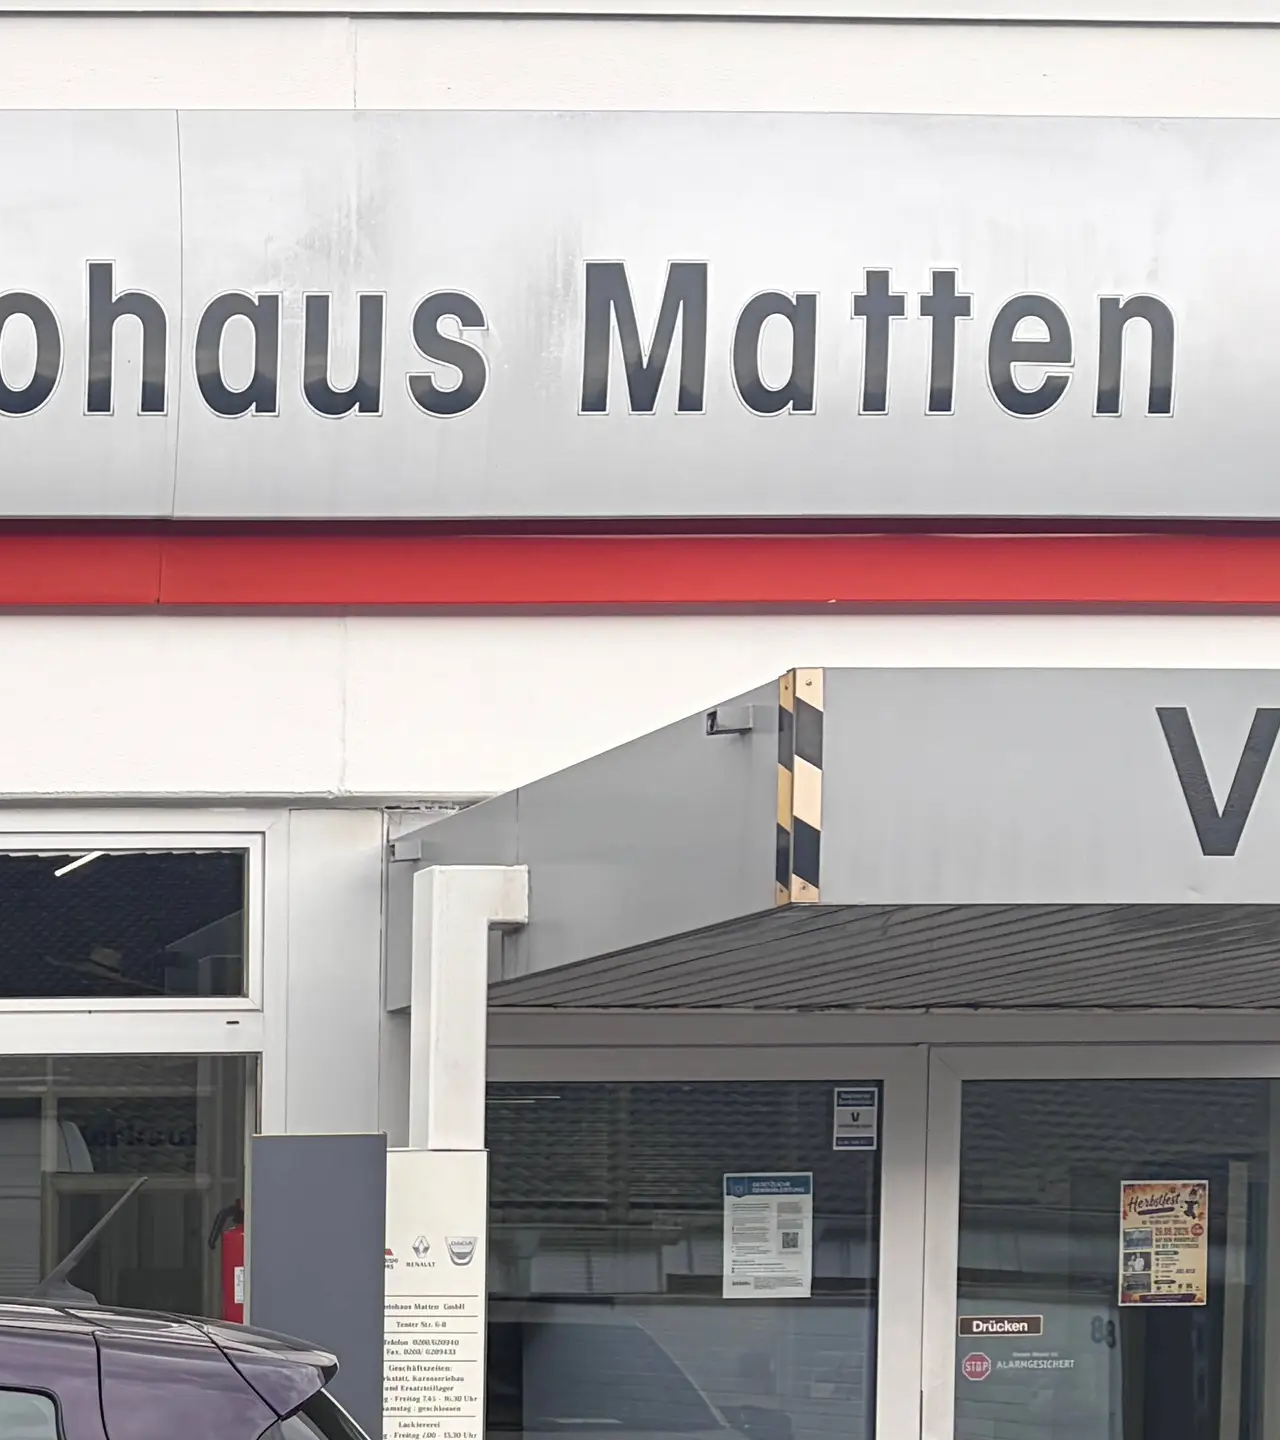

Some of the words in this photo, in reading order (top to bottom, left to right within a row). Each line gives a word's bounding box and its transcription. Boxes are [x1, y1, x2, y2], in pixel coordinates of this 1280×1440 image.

[576, 258, 1179, 419] Matten
[1154, 706, 1280, 857] V
[972, 1320, 1028, 1333] Drücken
[965, 1361, 988, 1372] STOP
[996, 1360, 1075, 1369] ALARMGESICHERT
